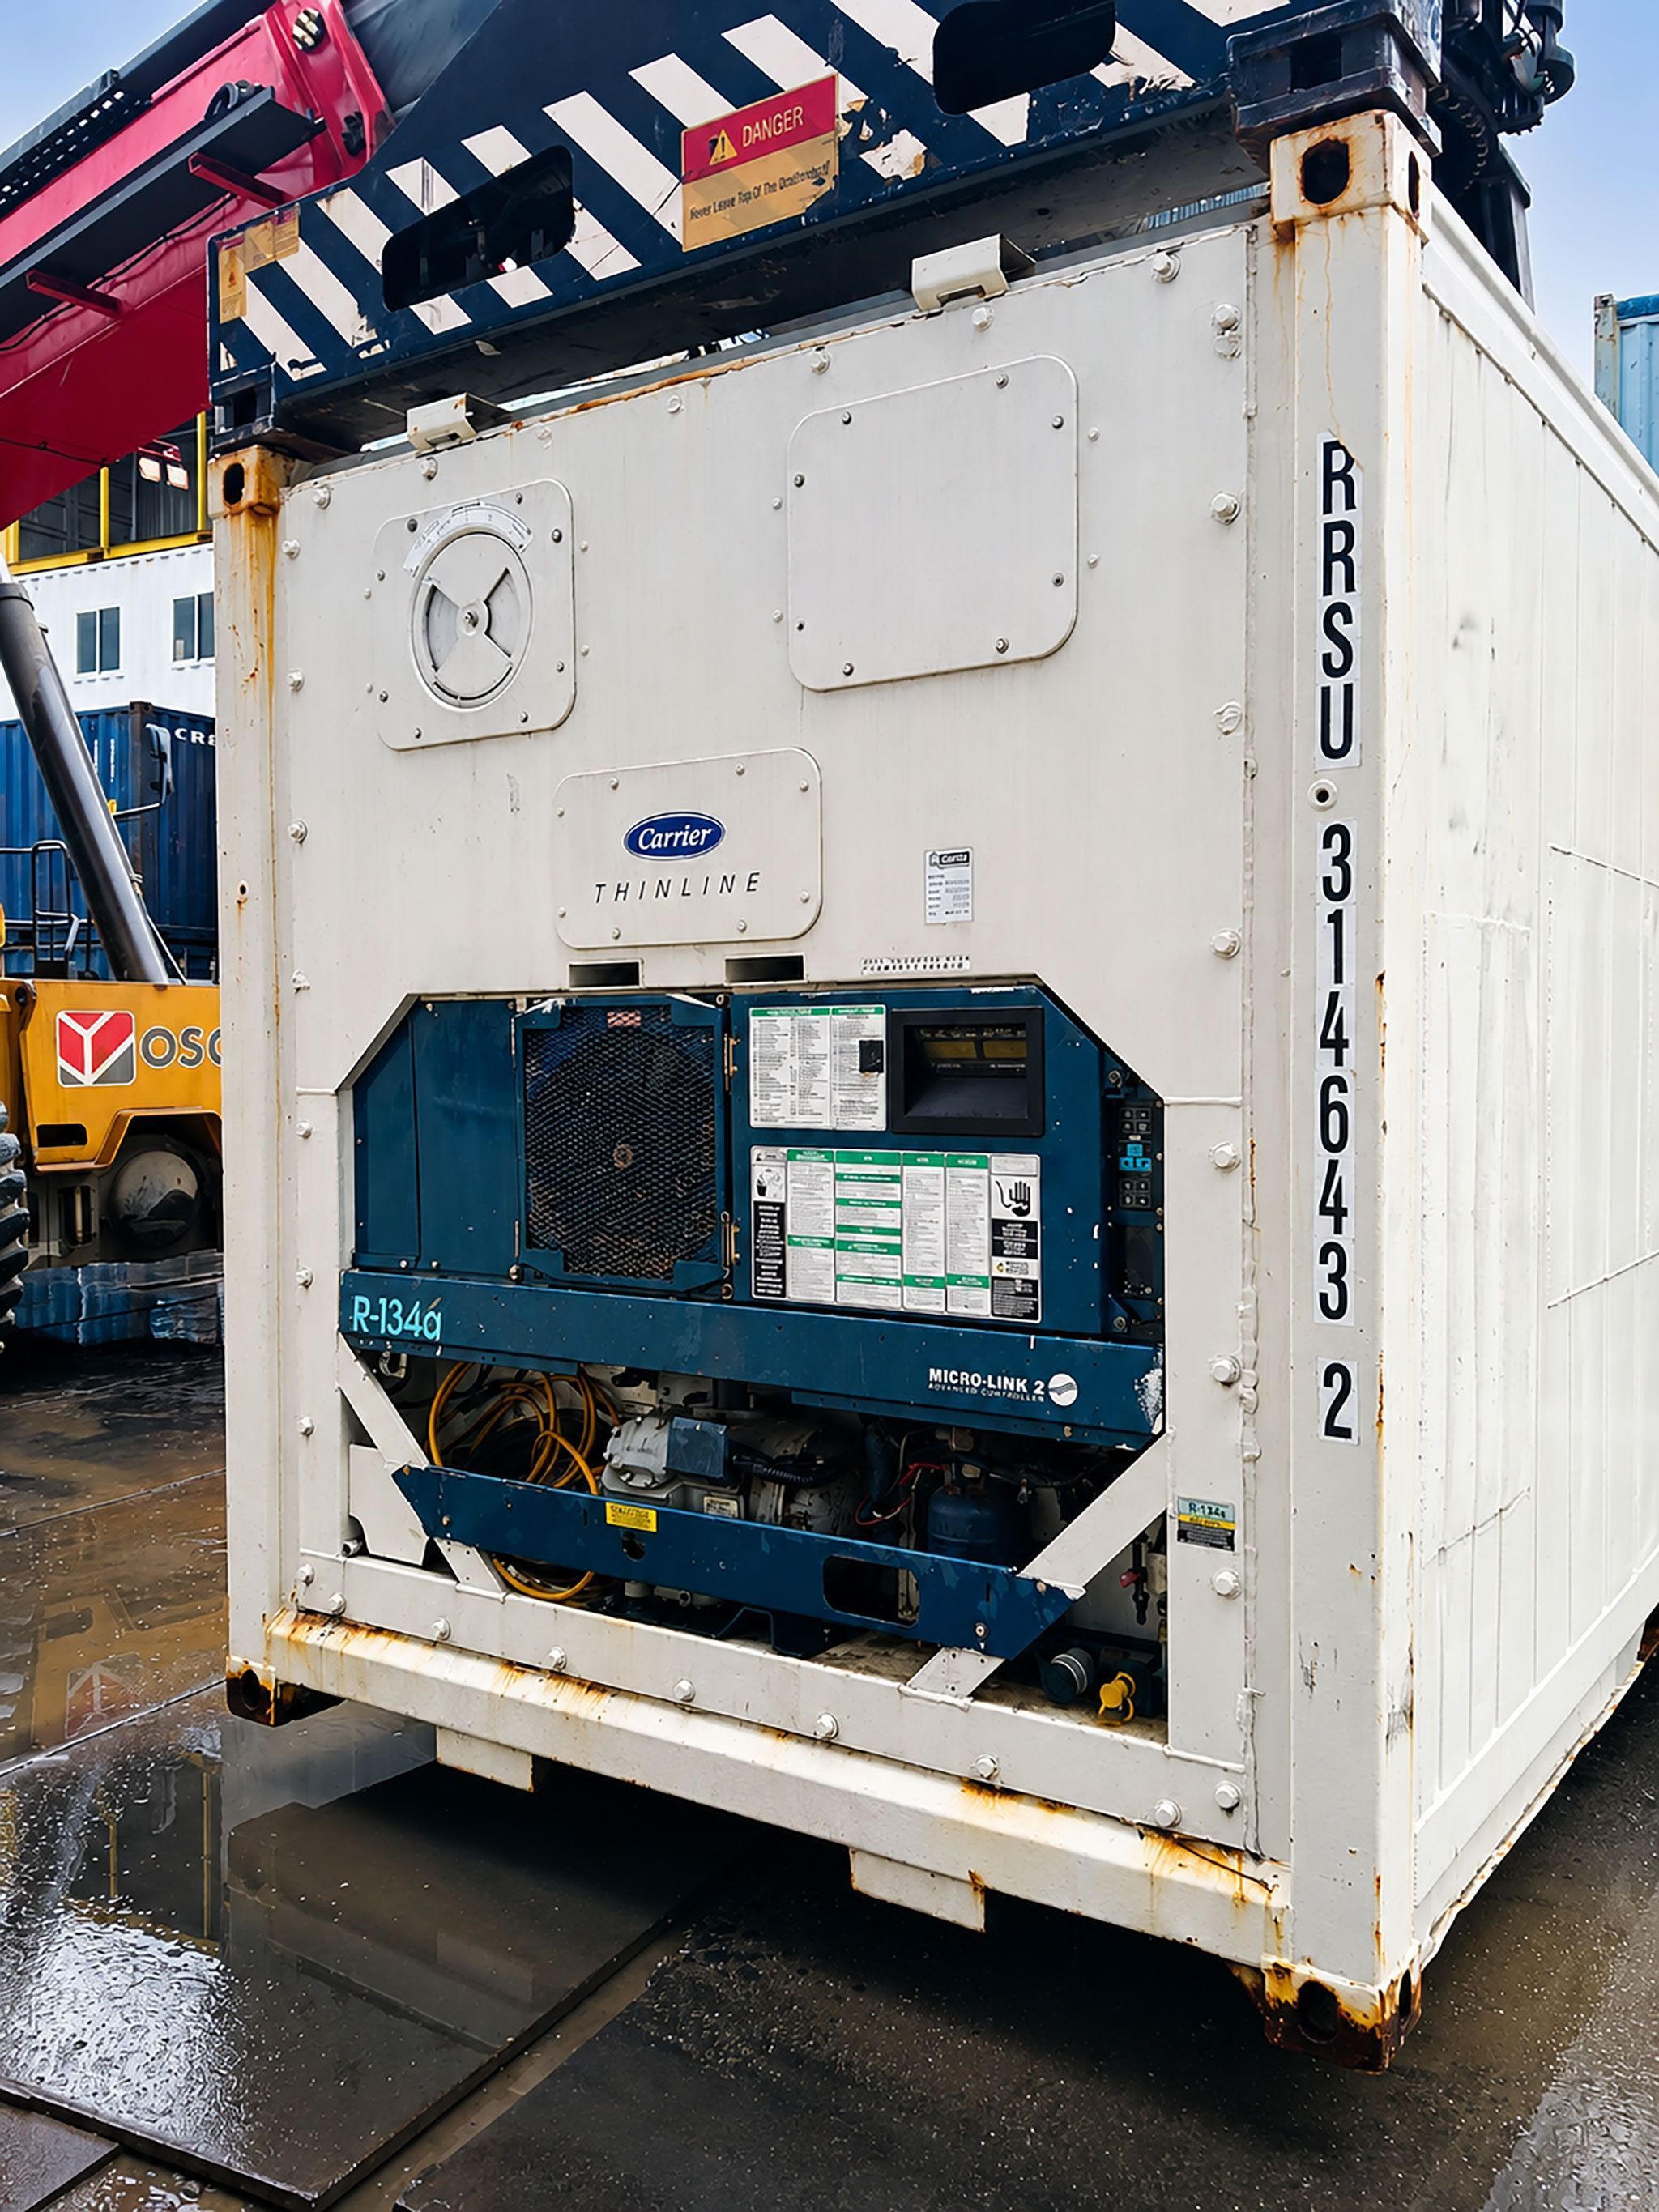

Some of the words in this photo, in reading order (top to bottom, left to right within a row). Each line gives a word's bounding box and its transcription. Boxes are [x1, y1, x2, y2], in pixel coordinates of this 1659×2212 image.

[742, 105, 804, 147] DANGER
[1320, 439, 1357, 760] RRSU
[638, 824, 711, 850] Carrier
[595, 872, 761, 904] THINLINE
[1318, 823, 1352, 1321] 314643
[928, 1367, 1028, 1393] MICRO-LINK
[1033, 1379, 1045, 1395] 2
[1323, 1362, 1353, 1440] 2
